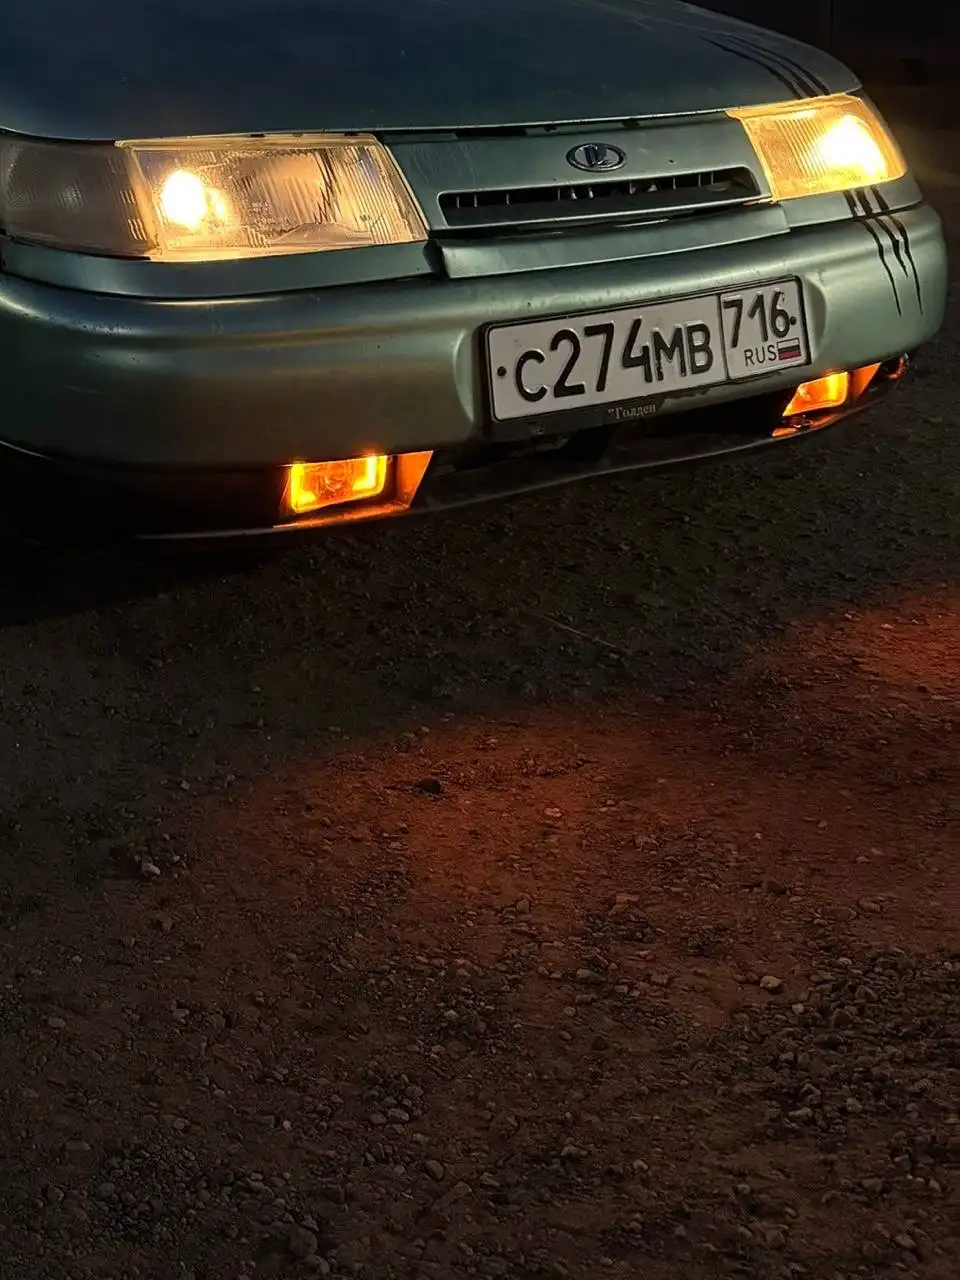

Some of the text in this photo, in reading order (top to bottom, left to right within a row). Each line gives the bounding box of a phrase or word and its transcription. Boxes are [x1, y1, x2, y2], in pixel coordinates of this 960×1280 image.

[515, 291, 791, 403] С274МВ 716
[745, 344, 777, 366] RUS
